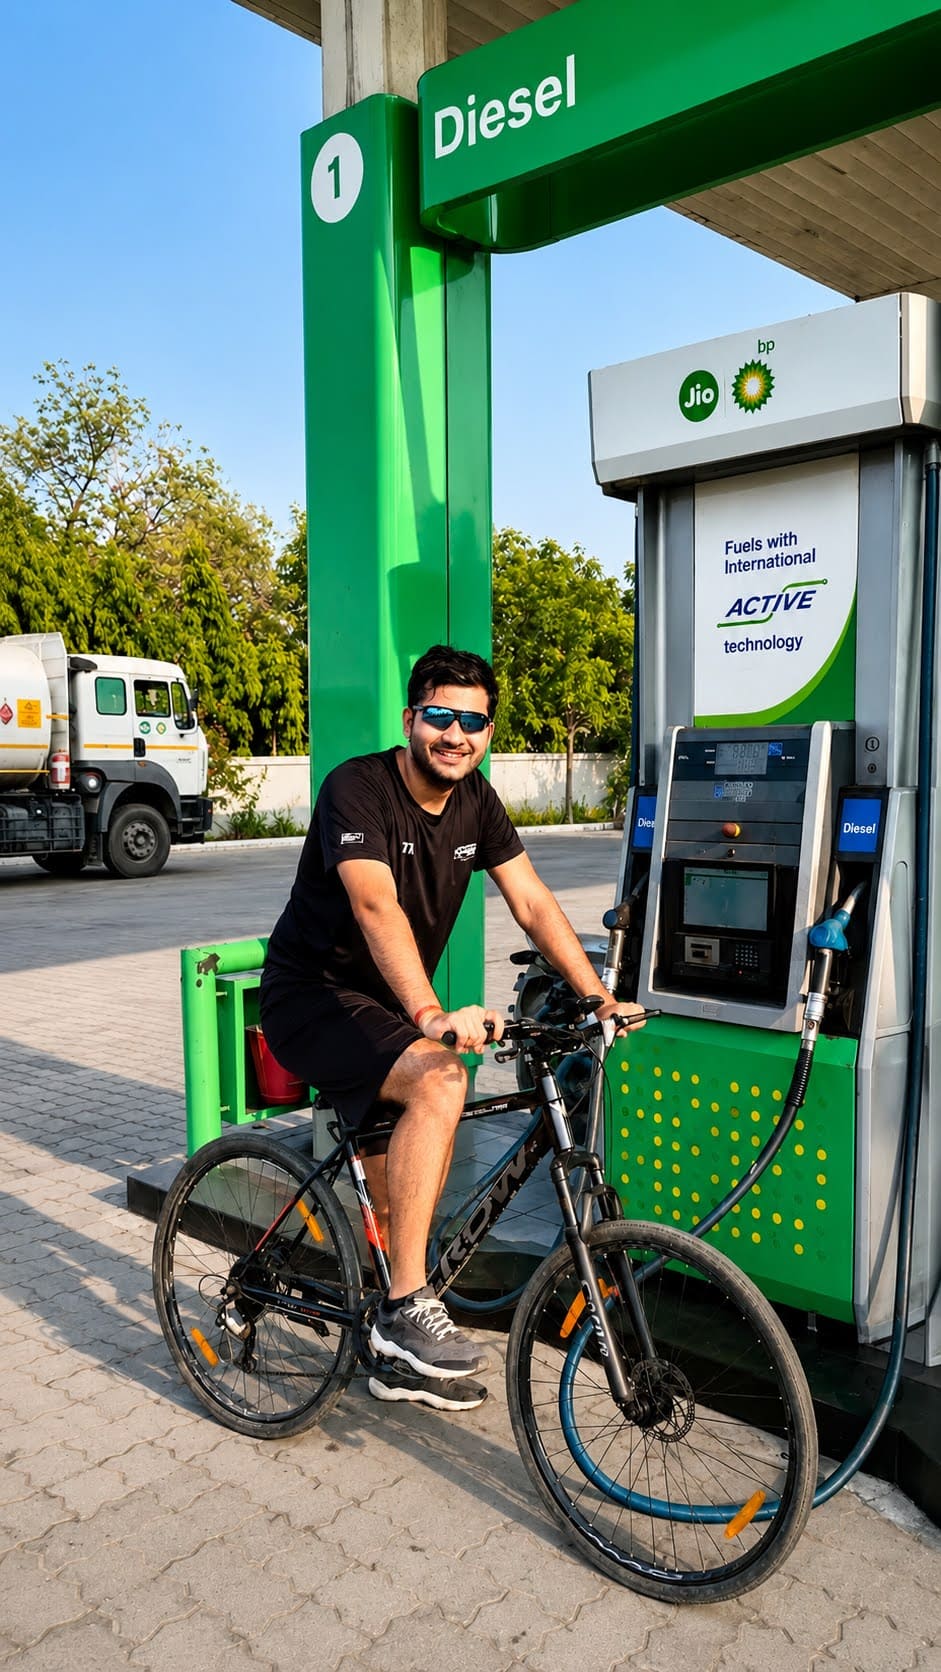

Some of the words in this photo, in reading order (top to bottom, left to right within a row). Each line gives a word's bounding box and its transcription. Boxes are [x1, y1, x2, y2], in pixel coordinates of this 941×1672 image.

[434, 54, 576, 159] Diesel
[327, 155, 341, 200] 1
[757, 339, 775, 355] bp
[684, 383, 715, 408] Jio
[725, 537, 763, 555] Fuels
[767, 531, 798, 549] with
[725, 548, 816, 574] International
[725, 590, 817, 618] ACTIVE
[724, 634, 804, 654] technology
[843, 822, 876, 834] Diesel
